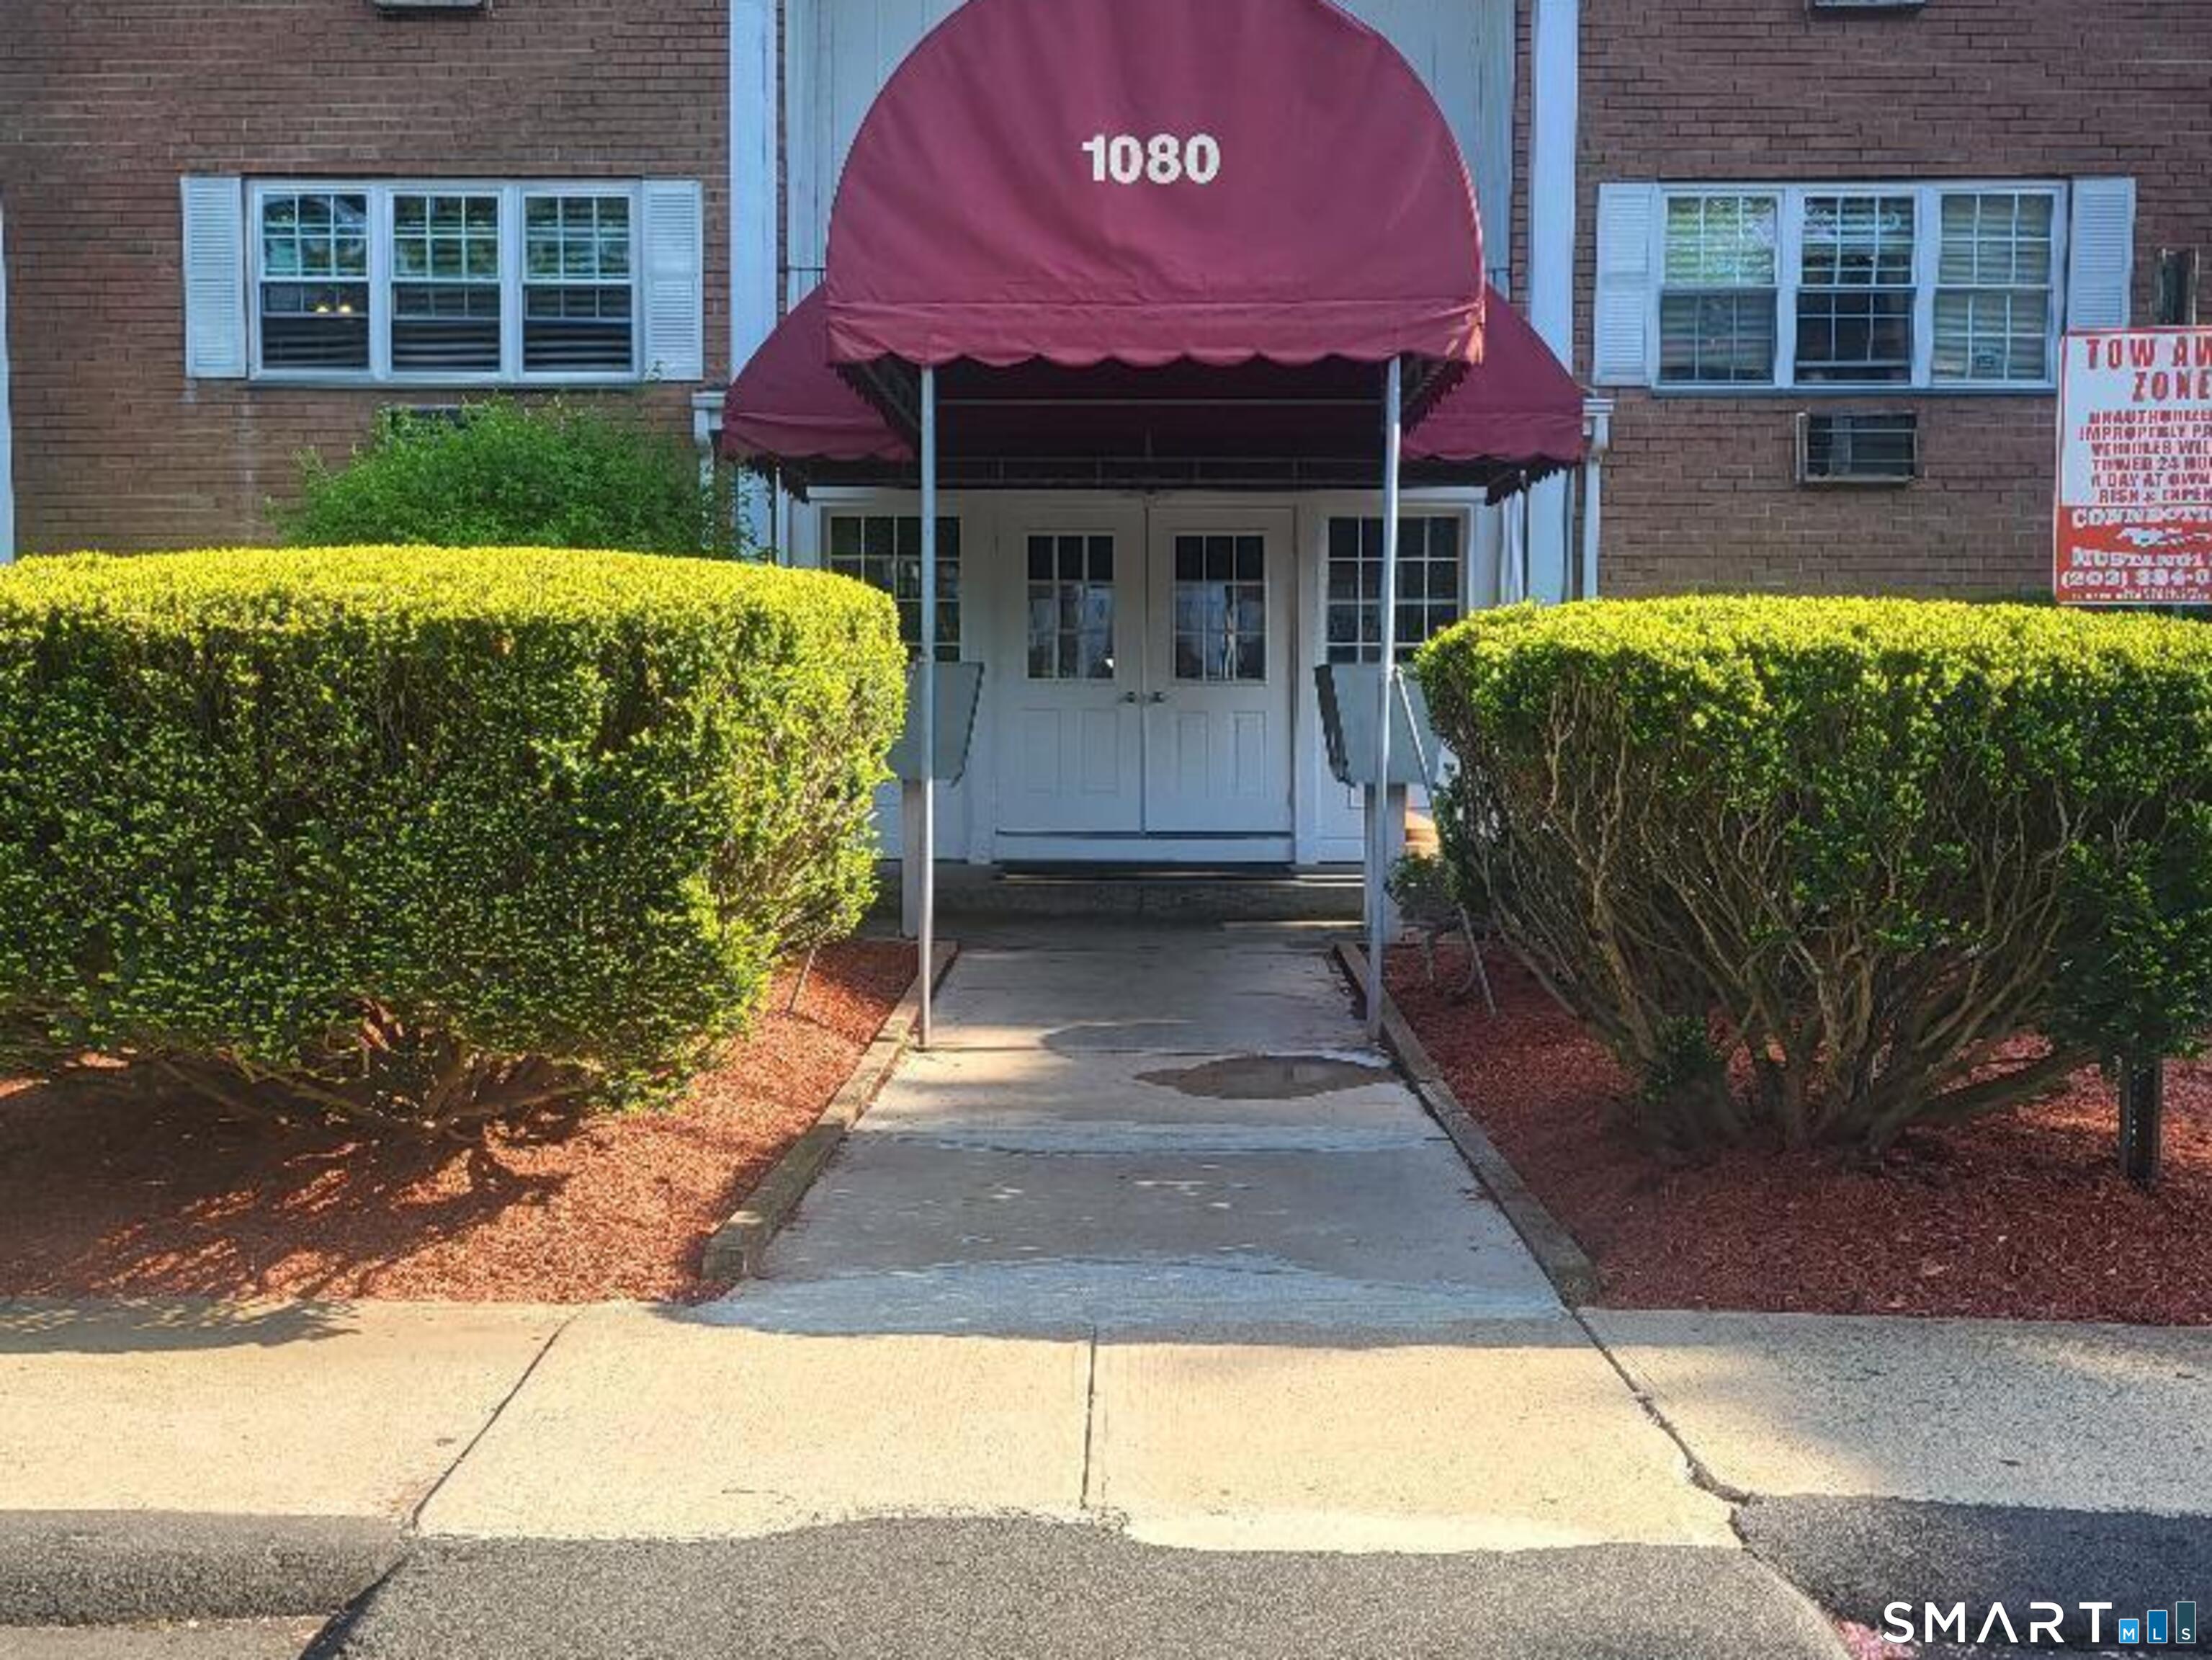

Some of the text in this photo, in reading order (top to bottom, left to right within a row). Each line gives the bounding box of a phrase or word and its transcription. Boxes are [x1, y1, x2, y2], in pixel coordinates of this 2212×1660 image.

[1082, 133, 1221, 184] 1080
[2086, 339, 2155, 370] TOW
[2132, 369, 2212, 402] ZONE
[2079, 425, 2185, 441] IMPROPERLY
[2090, 441, 2172, 456] VEHICLES
[2092, 457, 2152, 470] TOWED
[2157, 456, 2180, 470] 24
[2107, 473, 2139, 487] DAY
[2143, 473, 2162, 487] AT
[2168, 473, 2210, 486] OWN
[2099, 489, 2139, 504] RISK
